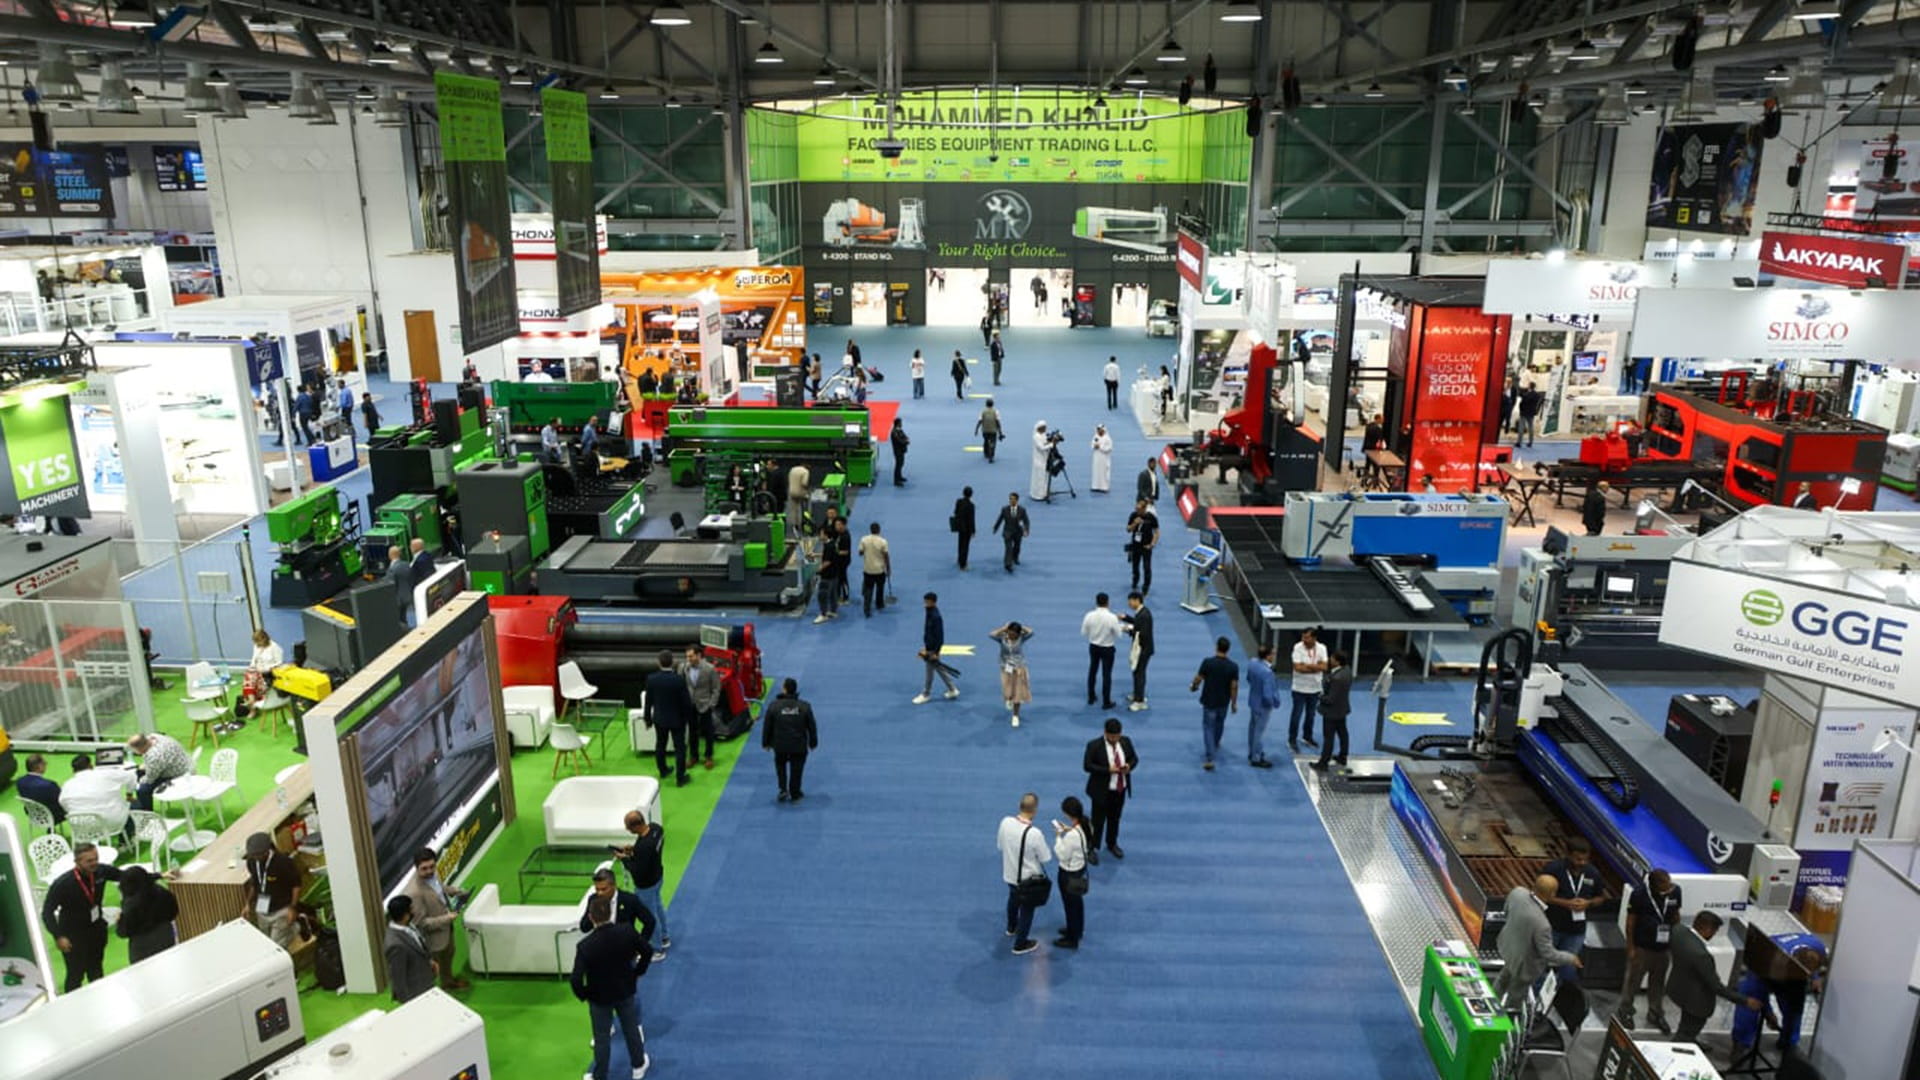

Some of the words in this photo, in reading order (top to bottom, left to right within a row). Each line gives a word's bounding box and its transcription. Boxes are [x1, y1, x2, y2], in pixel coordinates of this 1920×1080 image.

[1043, 107, 1149, 131] KHALID
[848, 138, 937, 151] FACRIES
[941, 138, 1035, 152] EQUIPMENT
[1038, 138, 1110, 152] TRADING
[1115, 138, 1158, 152] L.L.C.
[54, 175, 88, 187] STEEL
[57, 188, 102, 200] SUMMIT
[938, 242, 969, 256] Your
[972, 242, 1007, 260] Right
[1785, 248, 1884, 276] AKYAPAK
[1589, 285, 1638, 300] SIMC
[1767, 321, 1849, 341] SIMCO
[1431, 352, 1481, 363] FOLLOW
[1437, 363, 1455, 373] US
[1457, 363, 1473, 373] ON
[1428, 373, 1478, 384] SOCIAL
[1428, 384, 1477, 396] MEDIA
[18, 454, 71, 489] YES
[20, 485, 80, 514] MACHINERY
[1792, 602, 1908, 656] GGE
[1733, 643, 1784, 662] German
[1786, 655, 1814, 669] Gulf
[1816, 663, 1895, 690] Enterprises
